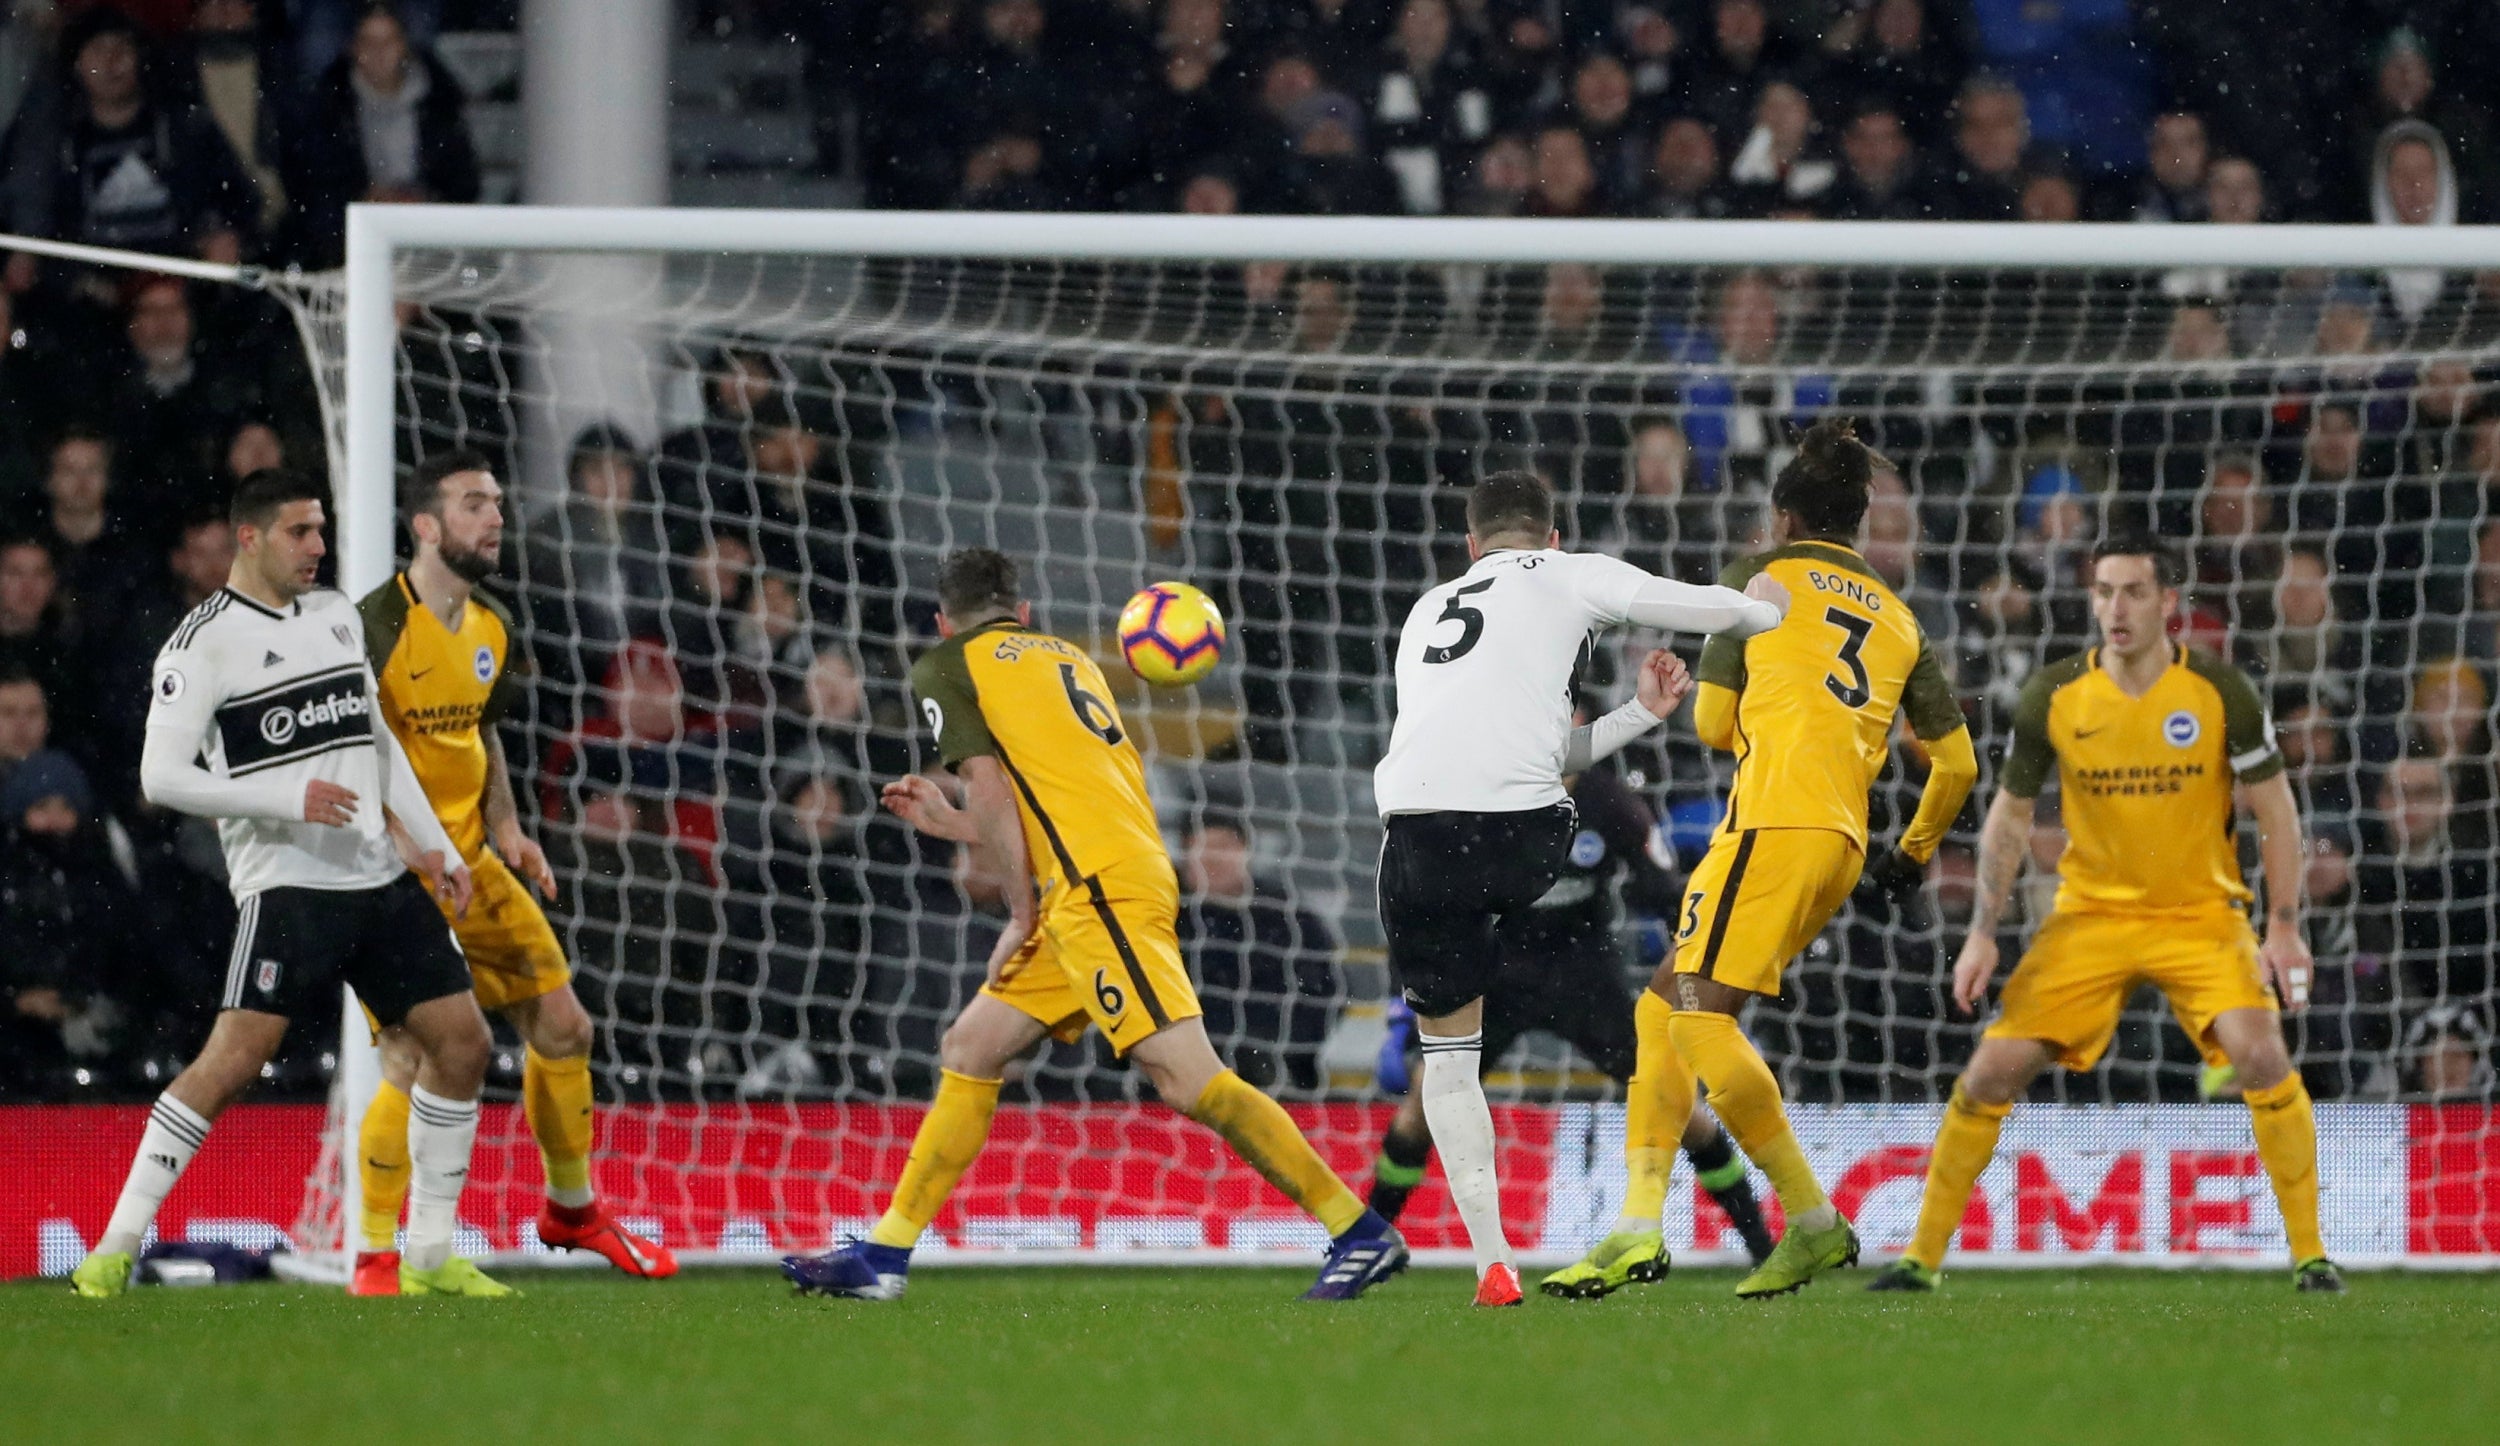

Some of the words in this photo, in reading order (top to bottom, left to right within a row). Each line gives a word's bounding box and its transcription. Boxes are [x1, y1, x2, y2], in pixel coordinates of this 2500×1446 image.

[1808, 570, 1882, 612] BONG
[1422, 575, 1498, 664] 5
[1823, 605, 1874, 709] 3
[1057, 662, 1123, 746] 6
[2076, 763, 2204, 782] AMERICAN
[1680, 891, 1706, 939] 3
[1094, 967, 1124, 1016] 6
